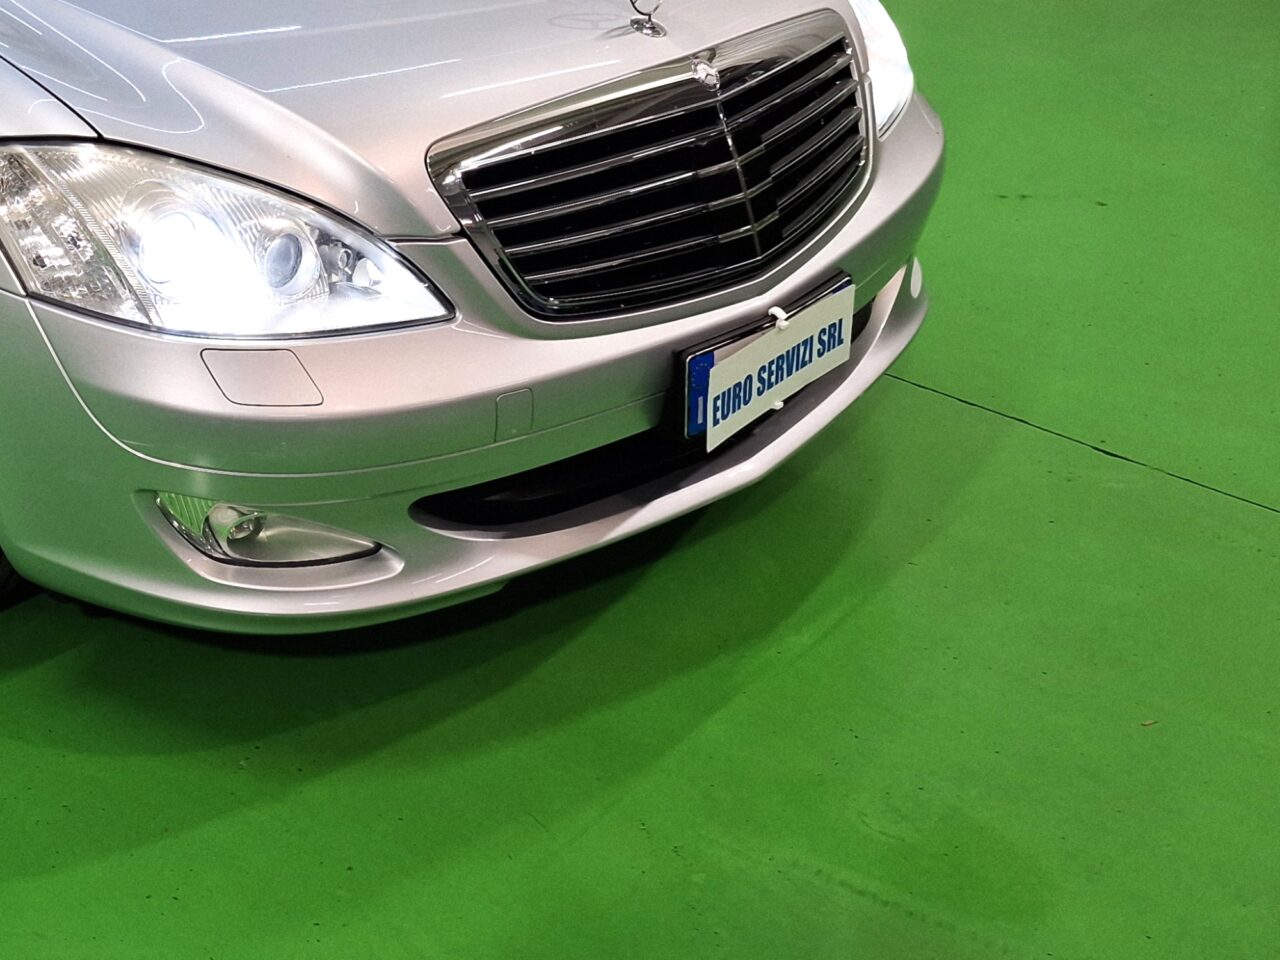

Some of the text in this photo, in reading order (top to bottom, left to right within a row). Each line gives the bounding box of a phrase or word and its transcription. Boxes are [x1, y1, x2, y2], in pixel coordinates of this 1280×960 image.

[712, 318, 845, 428] EURO SERVIZI SRL
